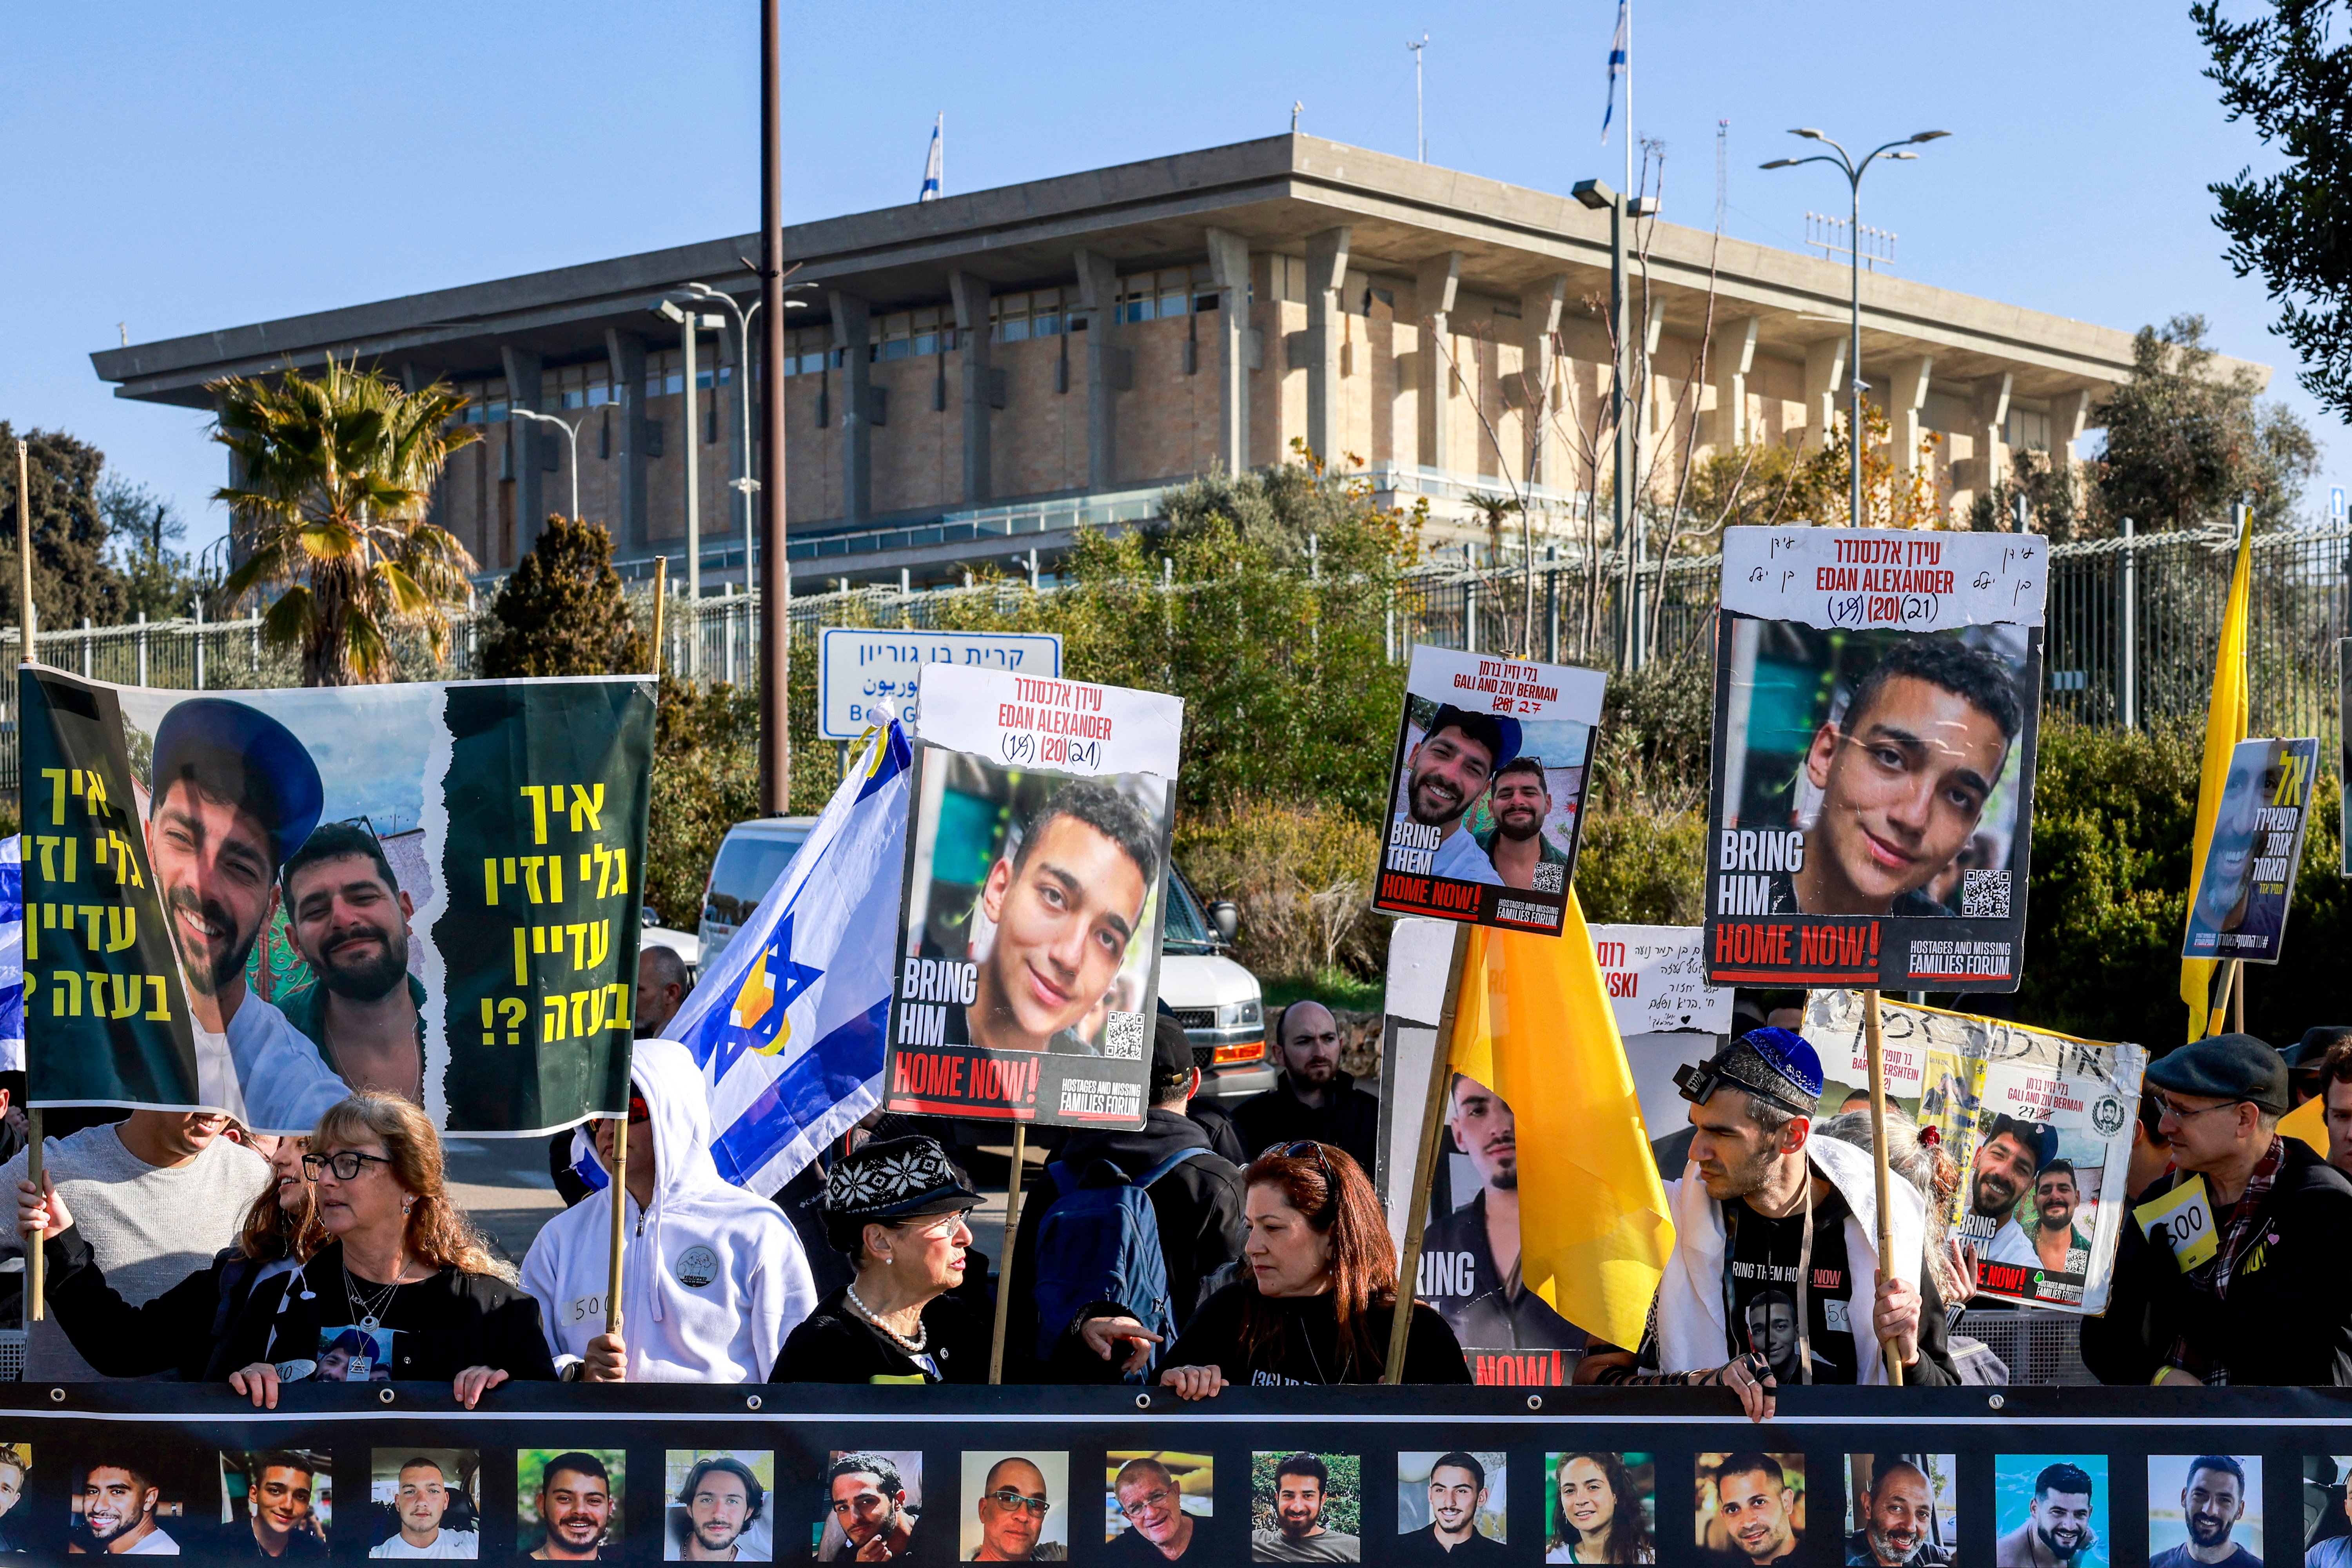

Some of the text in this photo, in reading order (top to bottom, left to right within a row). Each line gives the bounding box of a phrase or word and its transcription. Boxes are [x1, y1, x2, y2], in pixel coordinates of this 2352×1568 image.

[1834, 539, 1940, 568] עידן אלכסנדר
[1816, 567, 1954, 594] EDAN ALEXANDER
[860, 644, 918, 666] גוריון
[965, 648, 1024, 670] קרית
[1479, 661, 1538, 682] גלי וזיו ברמן
[863, 679, 918, 698] وريون
[1014, 677, 1102, 711] עידן אלכסנדר
[1454, 673, 1558, 702] GALI AND ZIV BERMAN
[1518, 701, 1542, 715] 27
[998, 703, 1112, 741] EDAN ALEXANDER
[2273, 750, 2309, 806] אל
[41, 768, 111, 825] איך
[520, 783, 604, 845] איך
[2254, 808, 2298, 831] תשאירו
[1390, 820, 1442, 851] BRING
[2267, 833, 2292, 857] אותי
[22, 829, 145, 889] גלי וזי
[1386, 846, 1433, 876] THEM
[1719, 830, 1804, 873] BRING
[484, 843, 628, 906] גלי וזיו
[2252, 858, 2287, 882] מאחור
[1381, 873, 1482, 912] HOME NOW!
[1717, 875, 1771, 916] HIM
[1496, 908, 1559, 927] FAMILIES FORUM
[1498, 898, 1559, 915] HOSTAGES AND MISSING
[26, 903, 136, 960] עדיין
[1715, 921, 1882, 967] HOME NOW!
[514, 918, 609, 986] עדיין
[1910, 940, 2011, 956] HOSTAGES AND MISSING
[1909, 954, 2010, 976] FAMILIES FORUM
[902, 958, 978, 1005] BRING
[53, 970, 171, 1021] בעזה
[544, 983, 631, 1044] בעזה
[898, 1003, 947, 1047] HIM
[1852, 1057, 1868, 1071] BAR
[893, 1051, 1041, 1104] HOME NOW!
[1062, 1078, 1141, 1098] HOSTAGES AND MISSING
[1060, 1092, 1140, 1116] FAMILIES FORUM
[2007, 1087, 2025, 1102] GALI
[2025, 1091, 2039, 1105] AND
[2040, 1093, 2053, 1107] ZIV
[2053, 1096, 2084, 1112] BERMAN
[806, 1189, 828, 1205] Columbi
[1958, 1214, 1997, 1239] BRING
[1733, 1261, 1755, 1279] RING
[1813, 1269, 1841, 1285] NOW
[1987, 1265, 2026, 1291] NOW!
[2036, 1286, 2082, 1303] FAMILIES FORUM
[2058, 1282, 2066, 1290] AND
[2066, 1283, 2084, 1293] MISSING
[1828, 1304, 1849, 1323] 50
